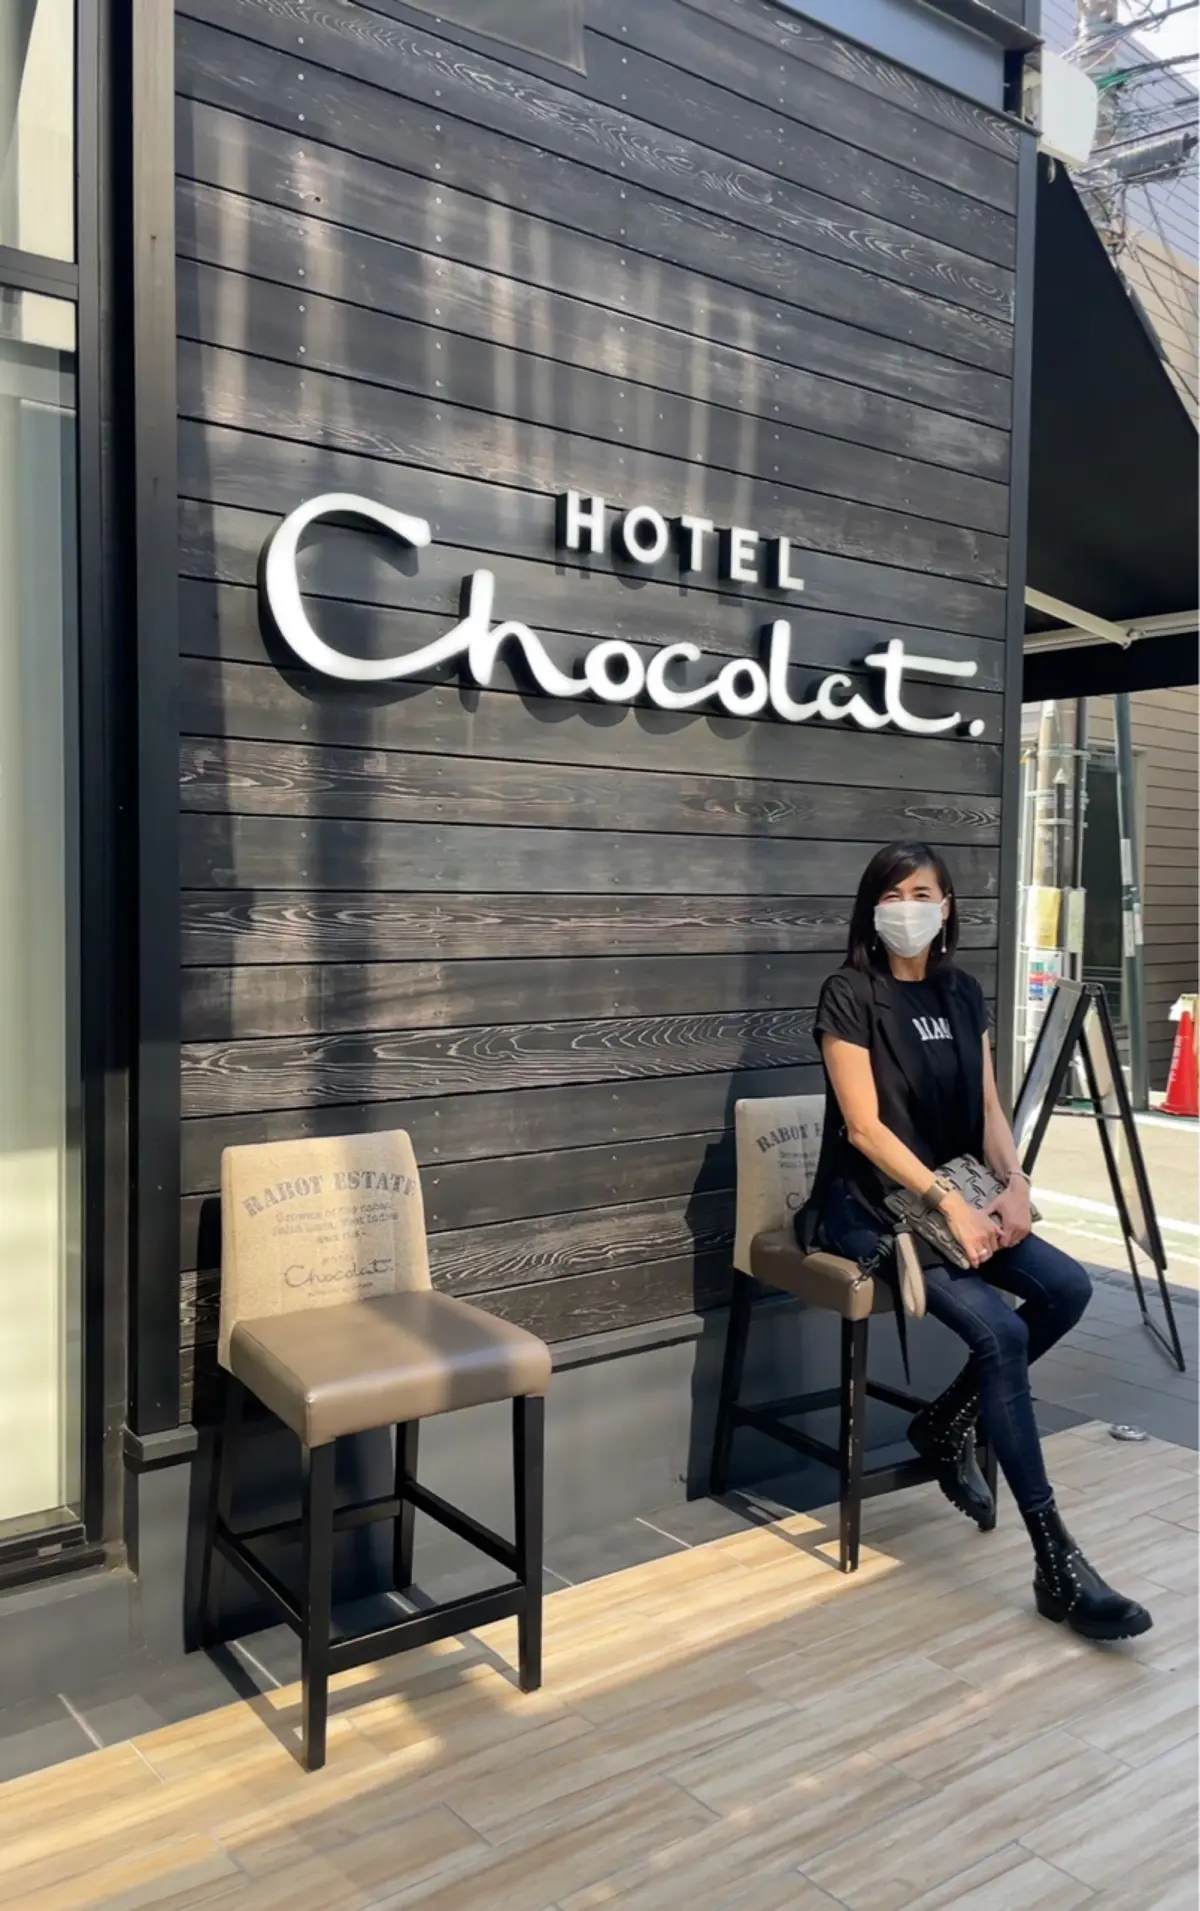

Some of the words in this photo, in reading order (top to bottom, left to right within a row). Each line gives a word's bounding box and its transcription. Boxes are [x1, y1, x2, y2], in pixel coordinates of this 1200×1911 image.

[564, 491, 805, 592] HOTEL
[265, 492, 985, 737] Chocolat.
[756, 1123, 809, 1153] RABOT
[241, 1174, 323, 1217] RABOT
[333, 1170, 417, 1197] ESTATE
